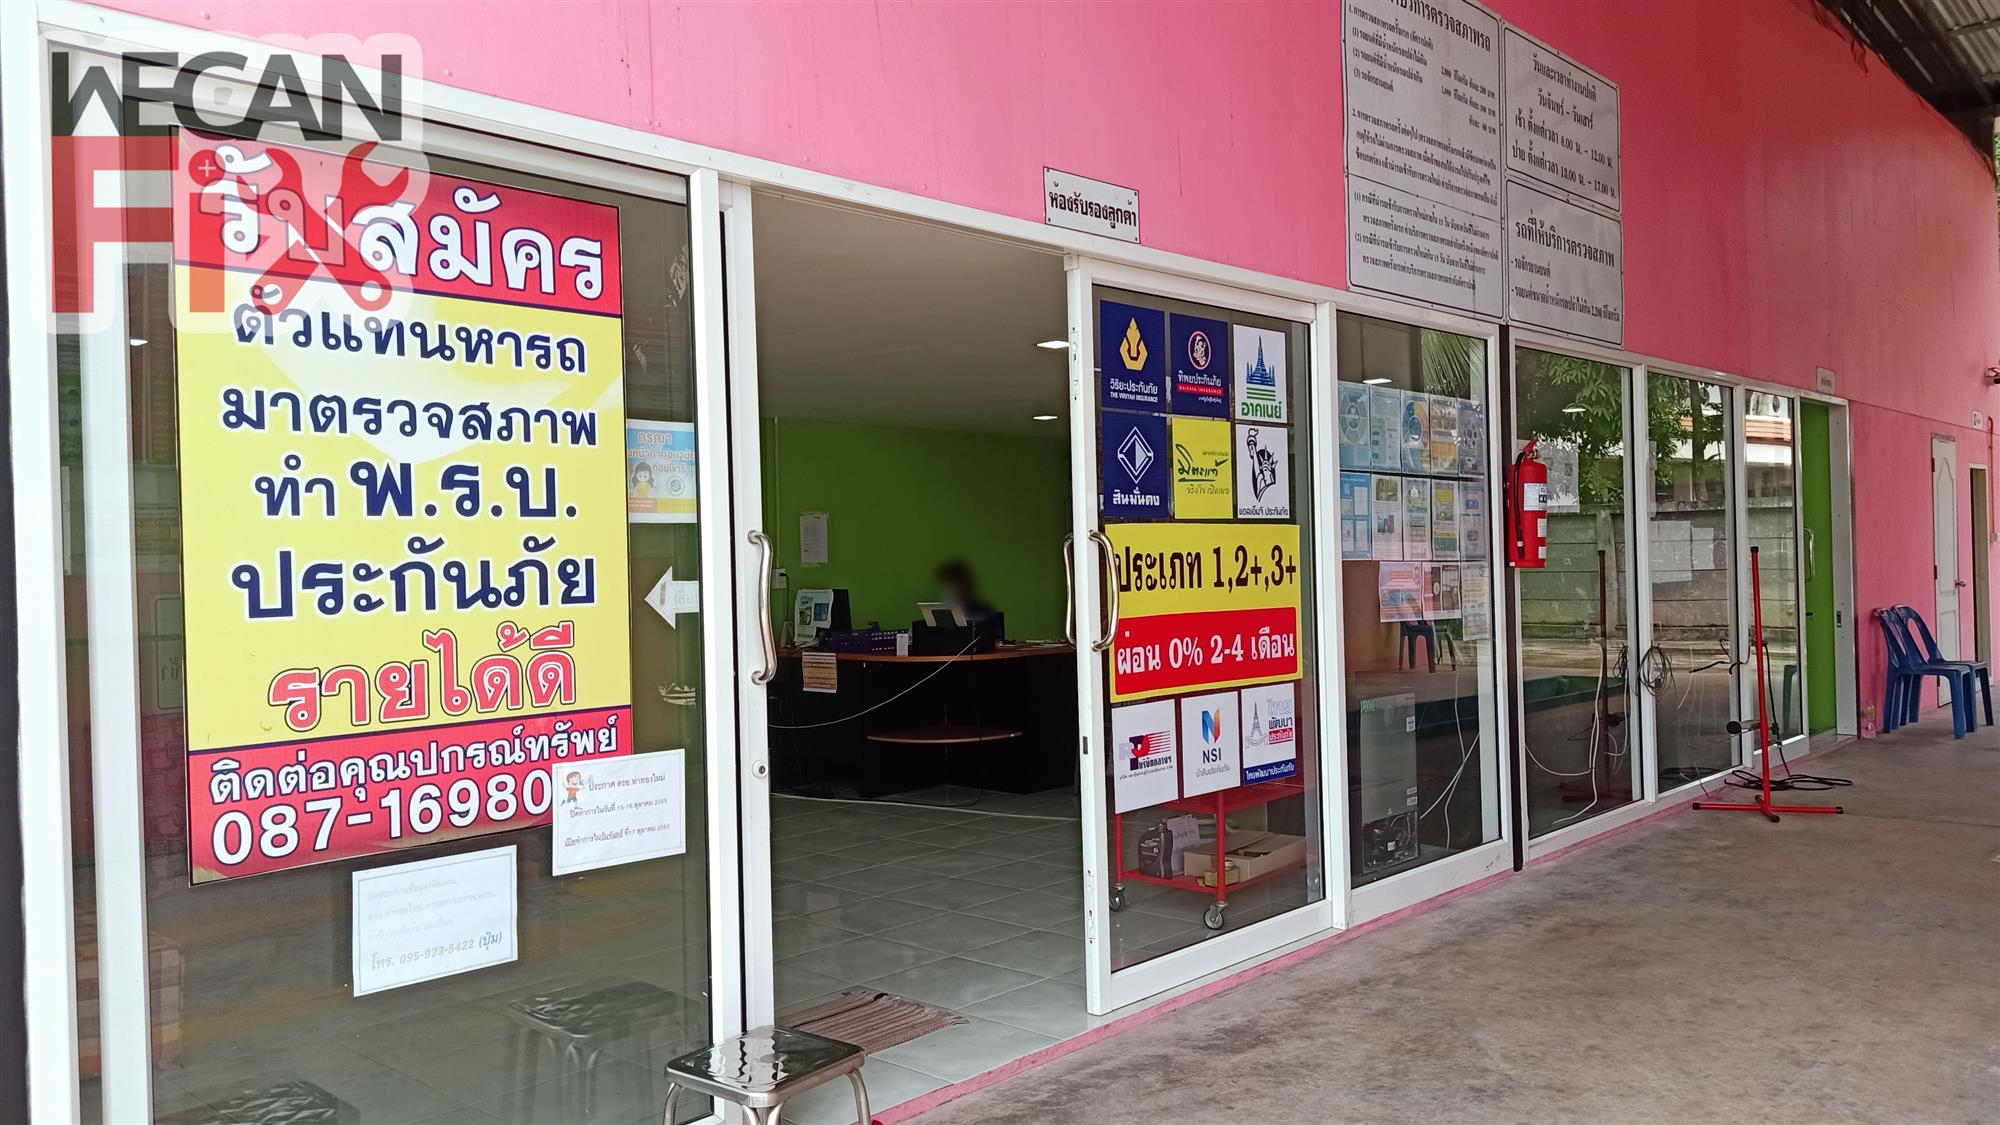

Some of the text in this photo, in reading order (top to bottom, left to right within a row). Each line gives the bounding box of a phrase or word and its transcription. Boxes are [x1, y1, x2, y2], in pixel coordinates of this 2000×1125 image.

[1048, 181, 1137, 230] ห้องรับรองลูกค้า
[233, 283, 587, 373] ตัวแทนหารถ
[221, 387, 597, 446] มาตรวจสภาพ
[1241, 400, 1282, 420] อาคเนย์
[255, 455, 579, 519] ทำ พ.ร.บ.
[1112, 486, 1160, 506] สินมั่นคง
[231, 534, 597, 619] ประกันภัย
[268, 620, 577, 732] รายได้ดี
[1117, 626, 1295, 675] ผ่อน 0% 2-4 เดือน
[210, 714, 618, 804] ติดต่อคุณปกรณ์ทรัพย์
[1202, 747, 1222, 764] NSI
[370, 952, 394, 971] โทร.
